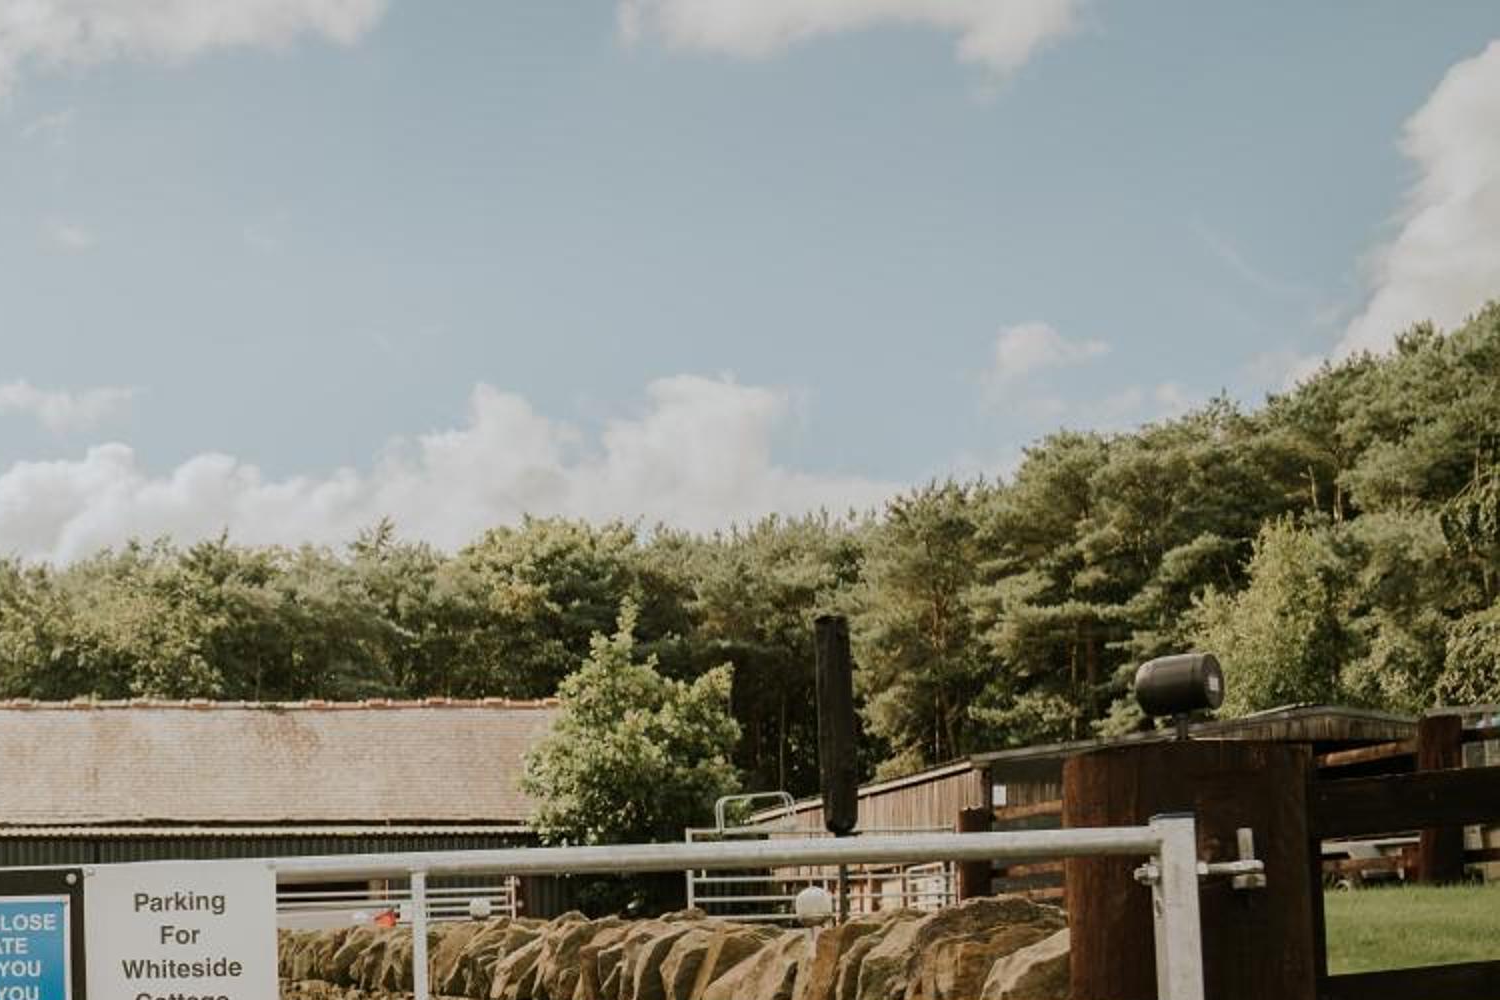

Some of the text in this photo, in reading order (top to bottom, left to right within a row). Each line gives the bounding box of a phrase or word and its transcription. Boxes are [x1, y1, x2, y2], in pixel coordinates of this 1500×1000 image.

[134, 893, 225, 915] Parking
[160, 926, 200, 944] For
[122, 958, 242, 980] Whiteside
